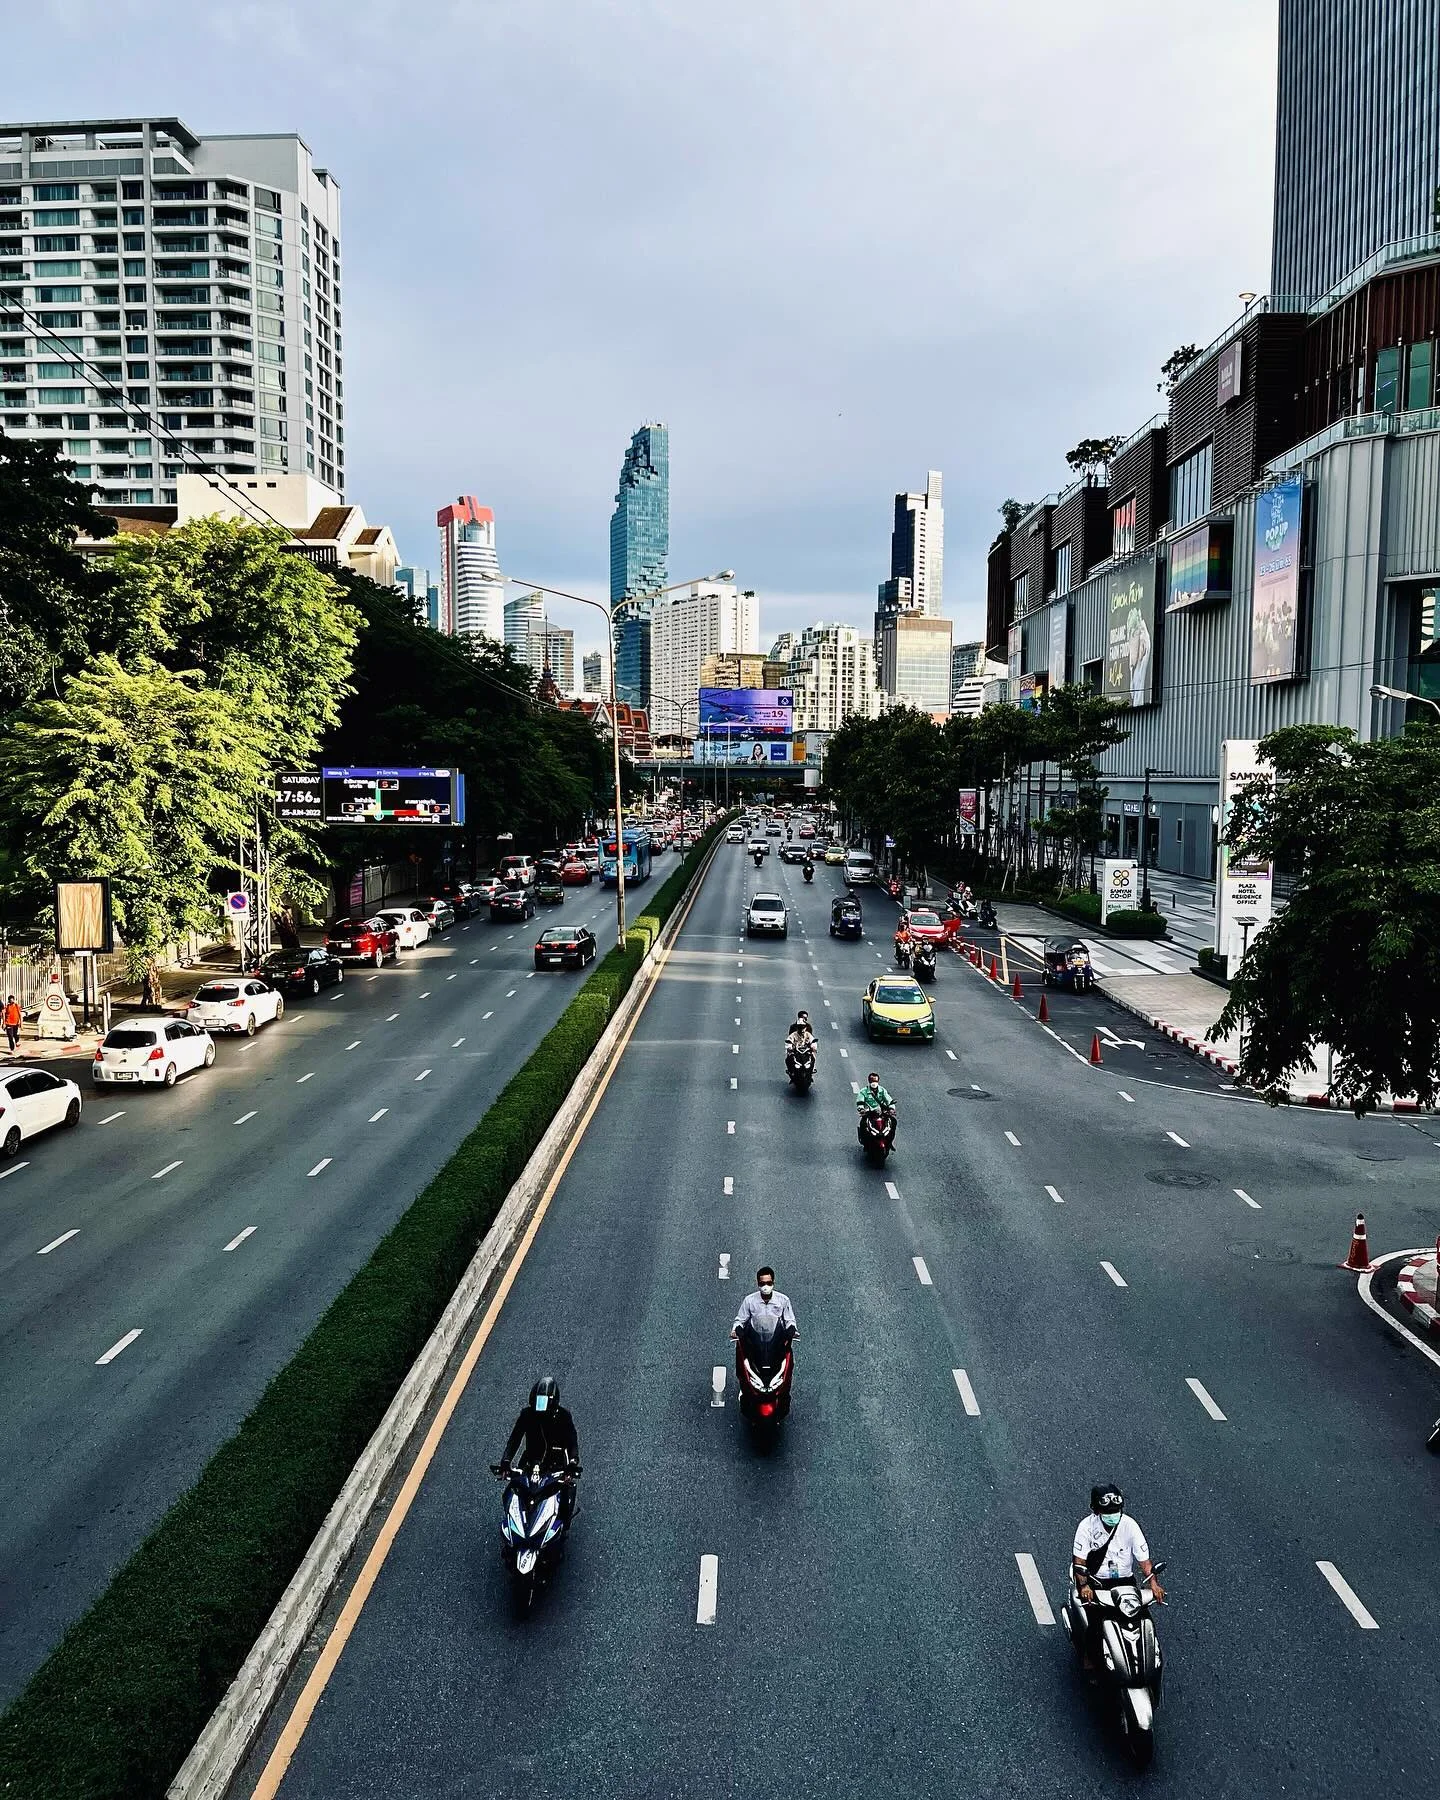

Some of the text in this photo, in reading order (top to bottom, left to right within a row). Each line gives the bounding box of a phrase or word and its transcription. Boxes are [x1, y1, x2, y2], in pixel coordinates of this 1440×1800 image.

[771, 710, 784, 718] 19
[281, 776, 321, 784] SATURDAY
[1229, 772, 1273, 781] SAMYAN
[275, 790, 314, 803] 17:56
[281, 808, 321, 816] 25-JUN-2022
